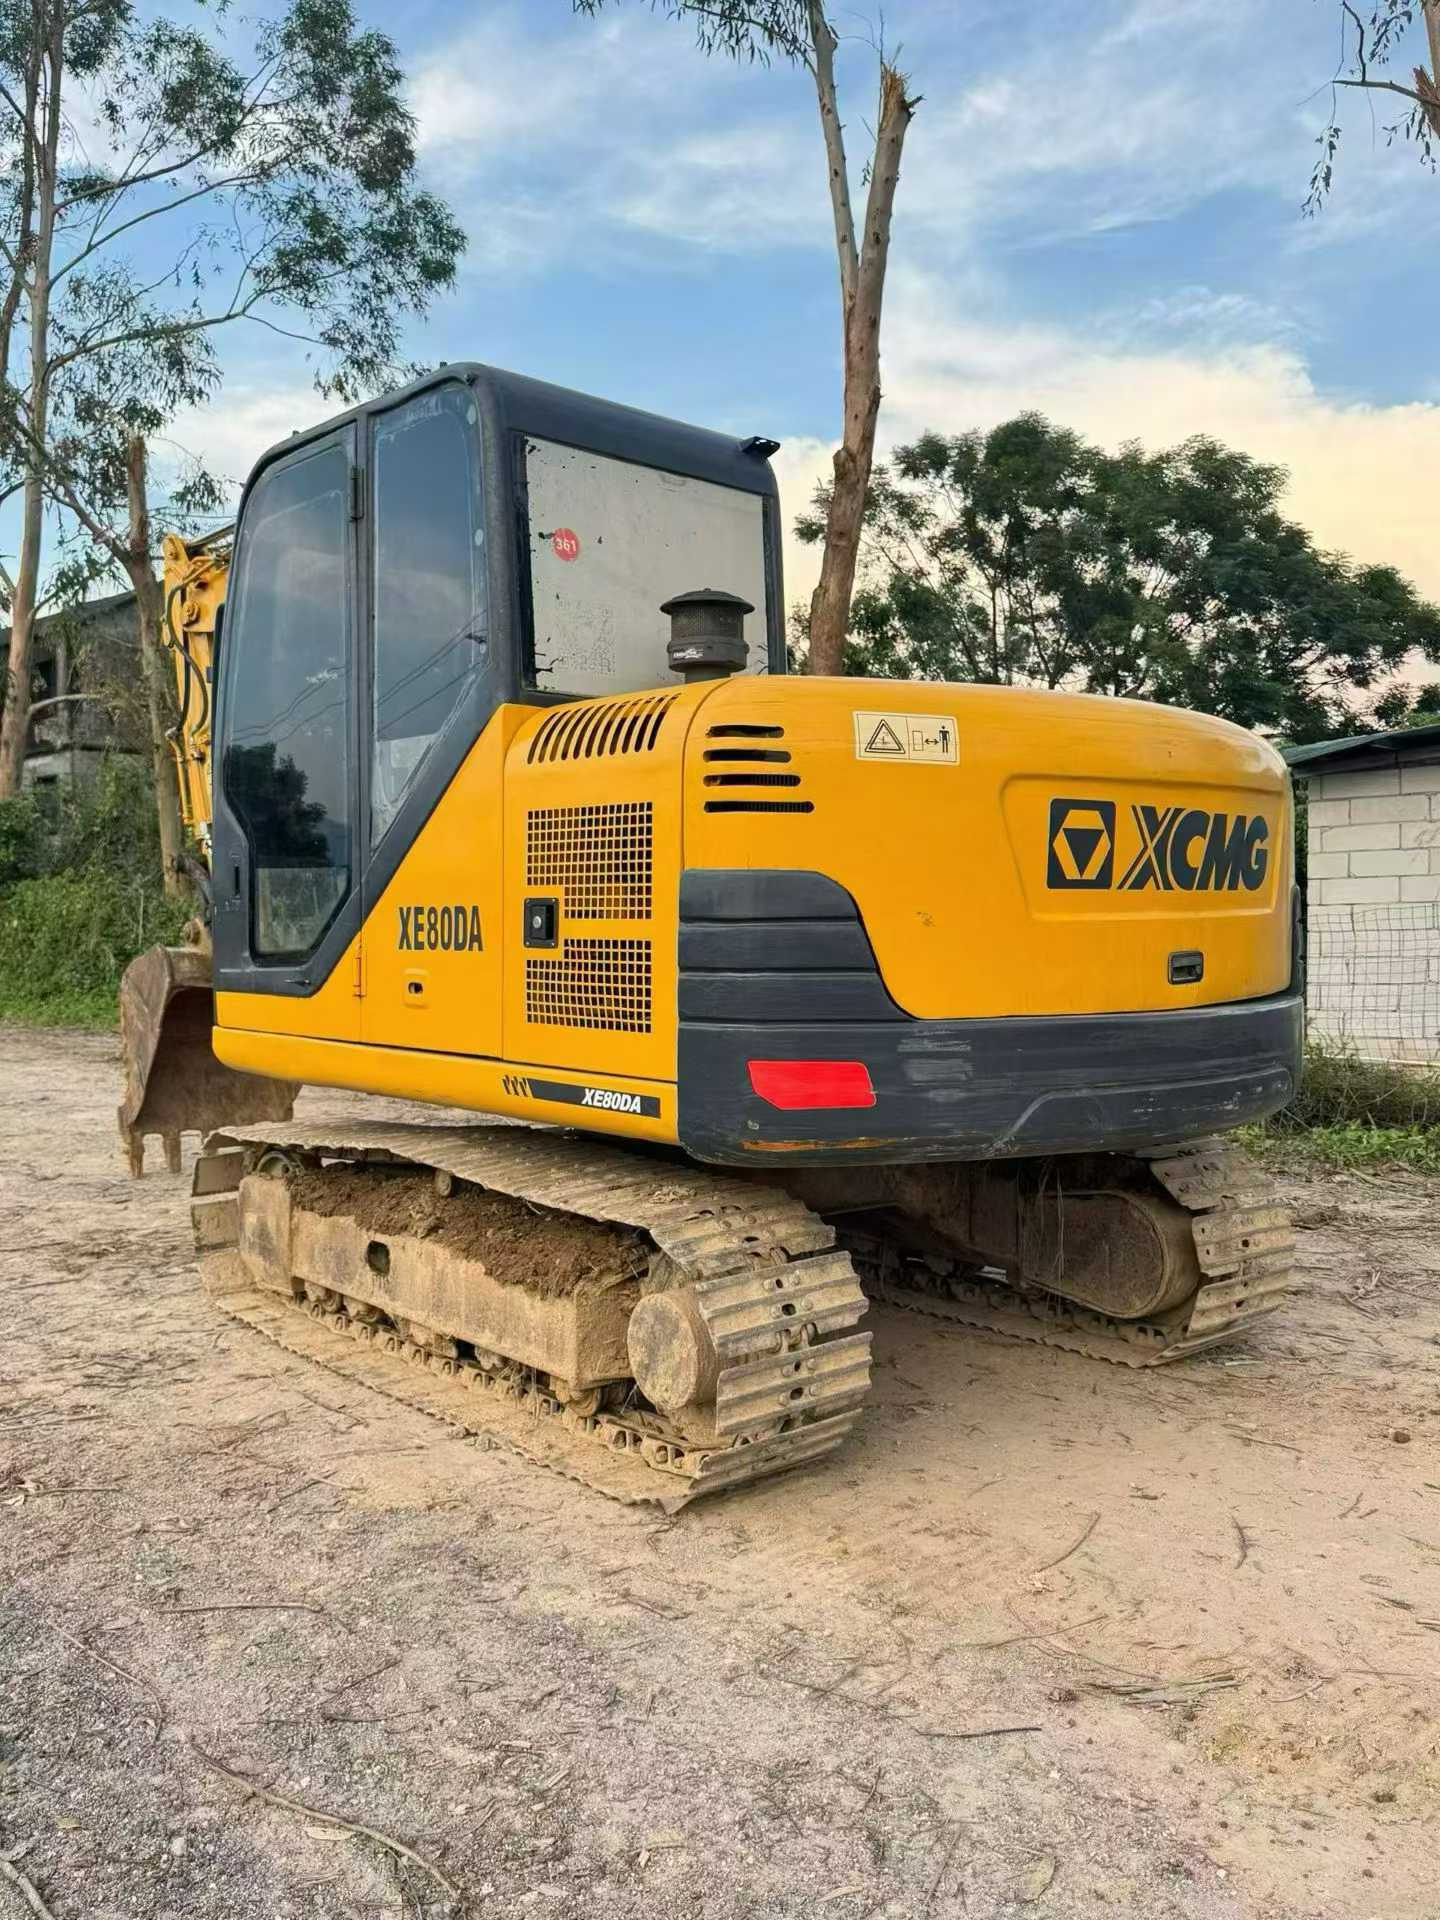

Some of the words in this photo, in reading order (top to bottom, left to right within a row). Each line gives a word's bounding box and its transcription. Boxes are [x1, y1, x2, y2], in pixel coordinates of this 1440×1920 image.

[555, 538, 577, 553] 361
[1116, 804, 1269, 891] XCMG
[398, 905, 484, 952] XE80DA
[581, 1088, 642, 1114] XE80DA
